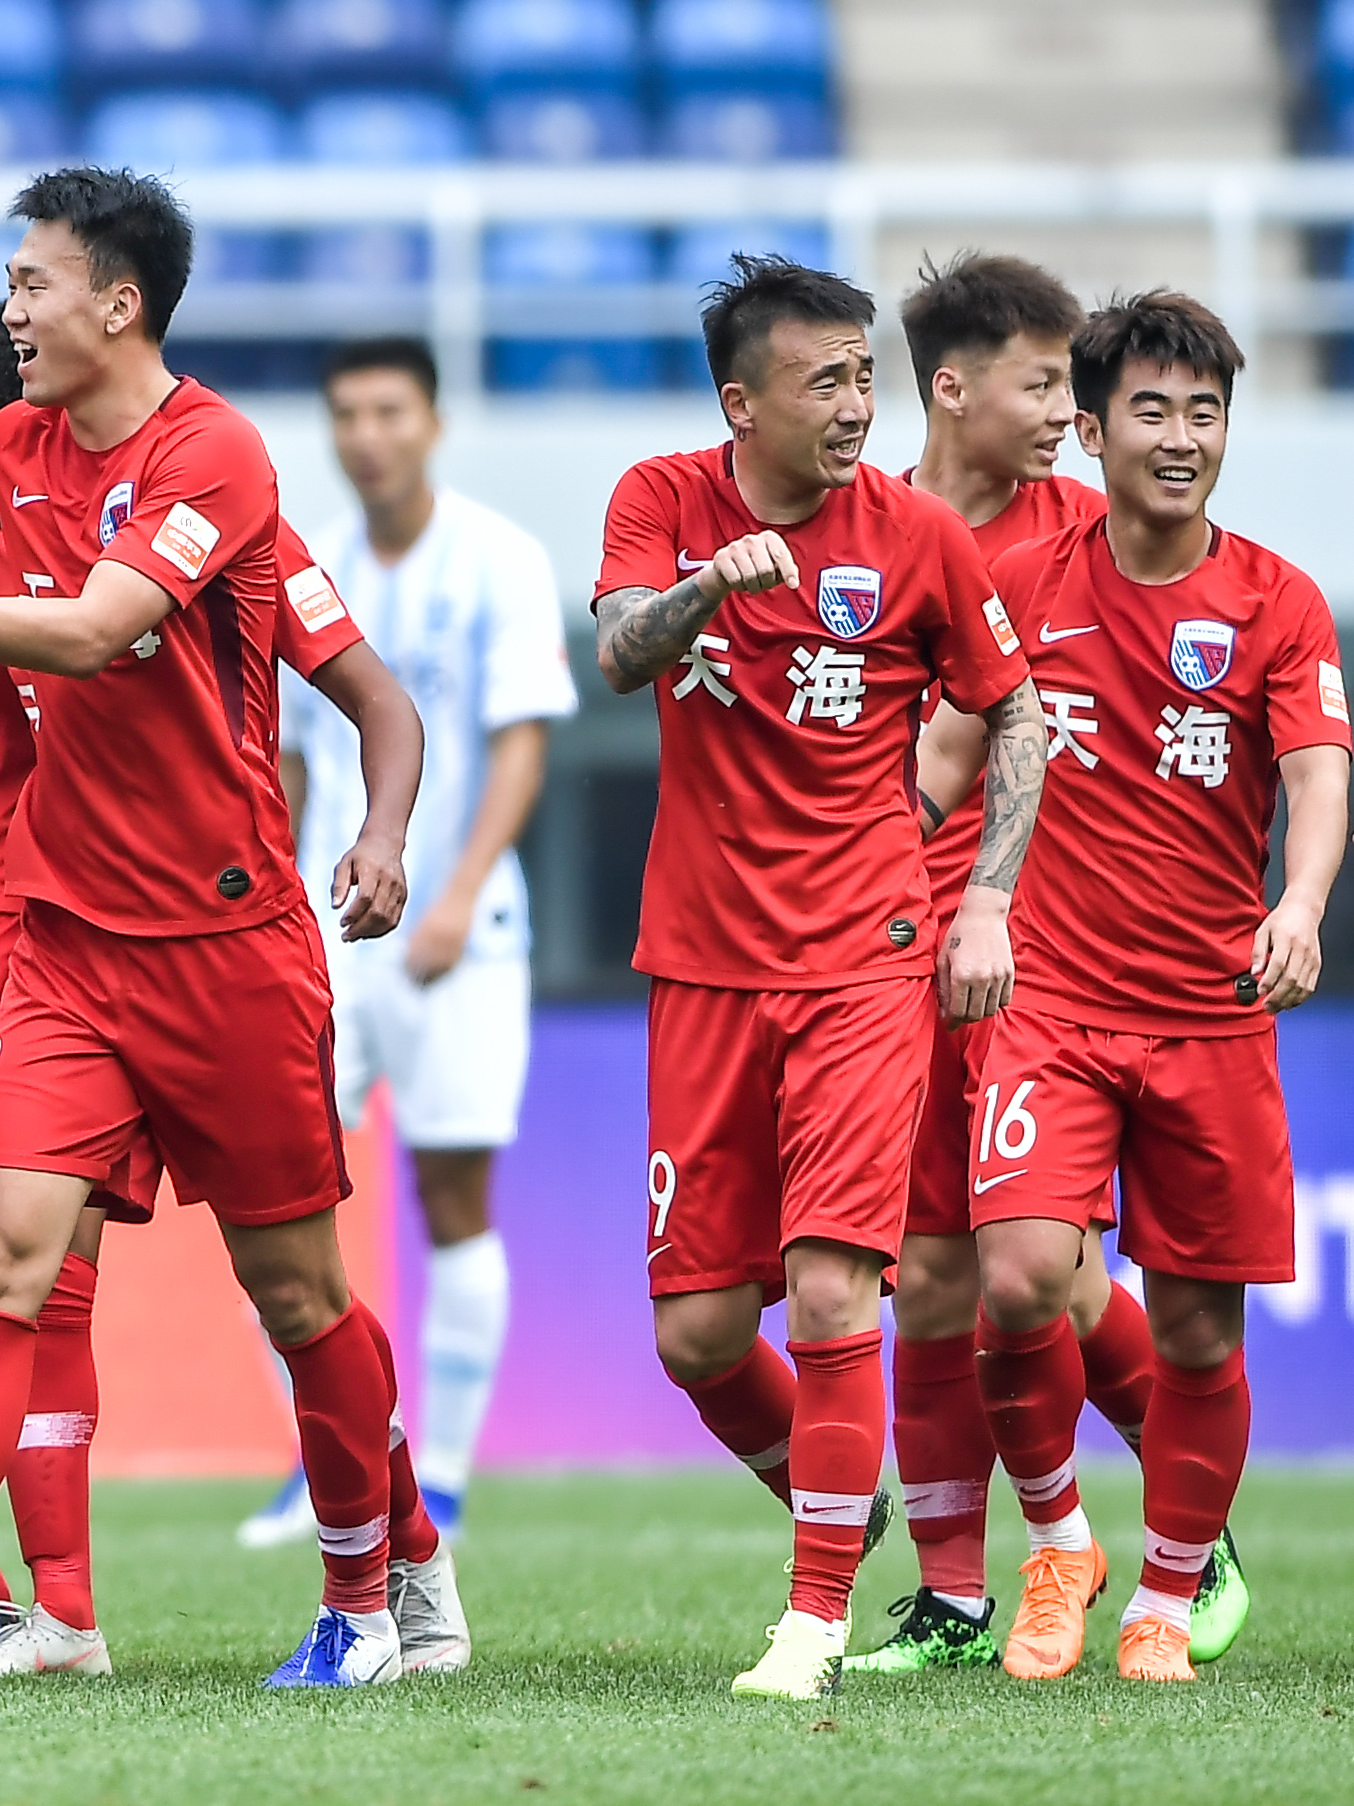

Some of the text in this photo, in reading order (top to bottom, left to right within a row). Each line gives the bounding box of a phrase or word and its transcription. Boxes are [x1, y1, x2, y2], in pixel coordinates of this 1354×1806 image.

[672, 632, 869, 729] 天海
[1038, 688, 1233, 789] 天海
[978, 1080, 1038, 1163] 16
[648, 1149, 676, 1238] 9
